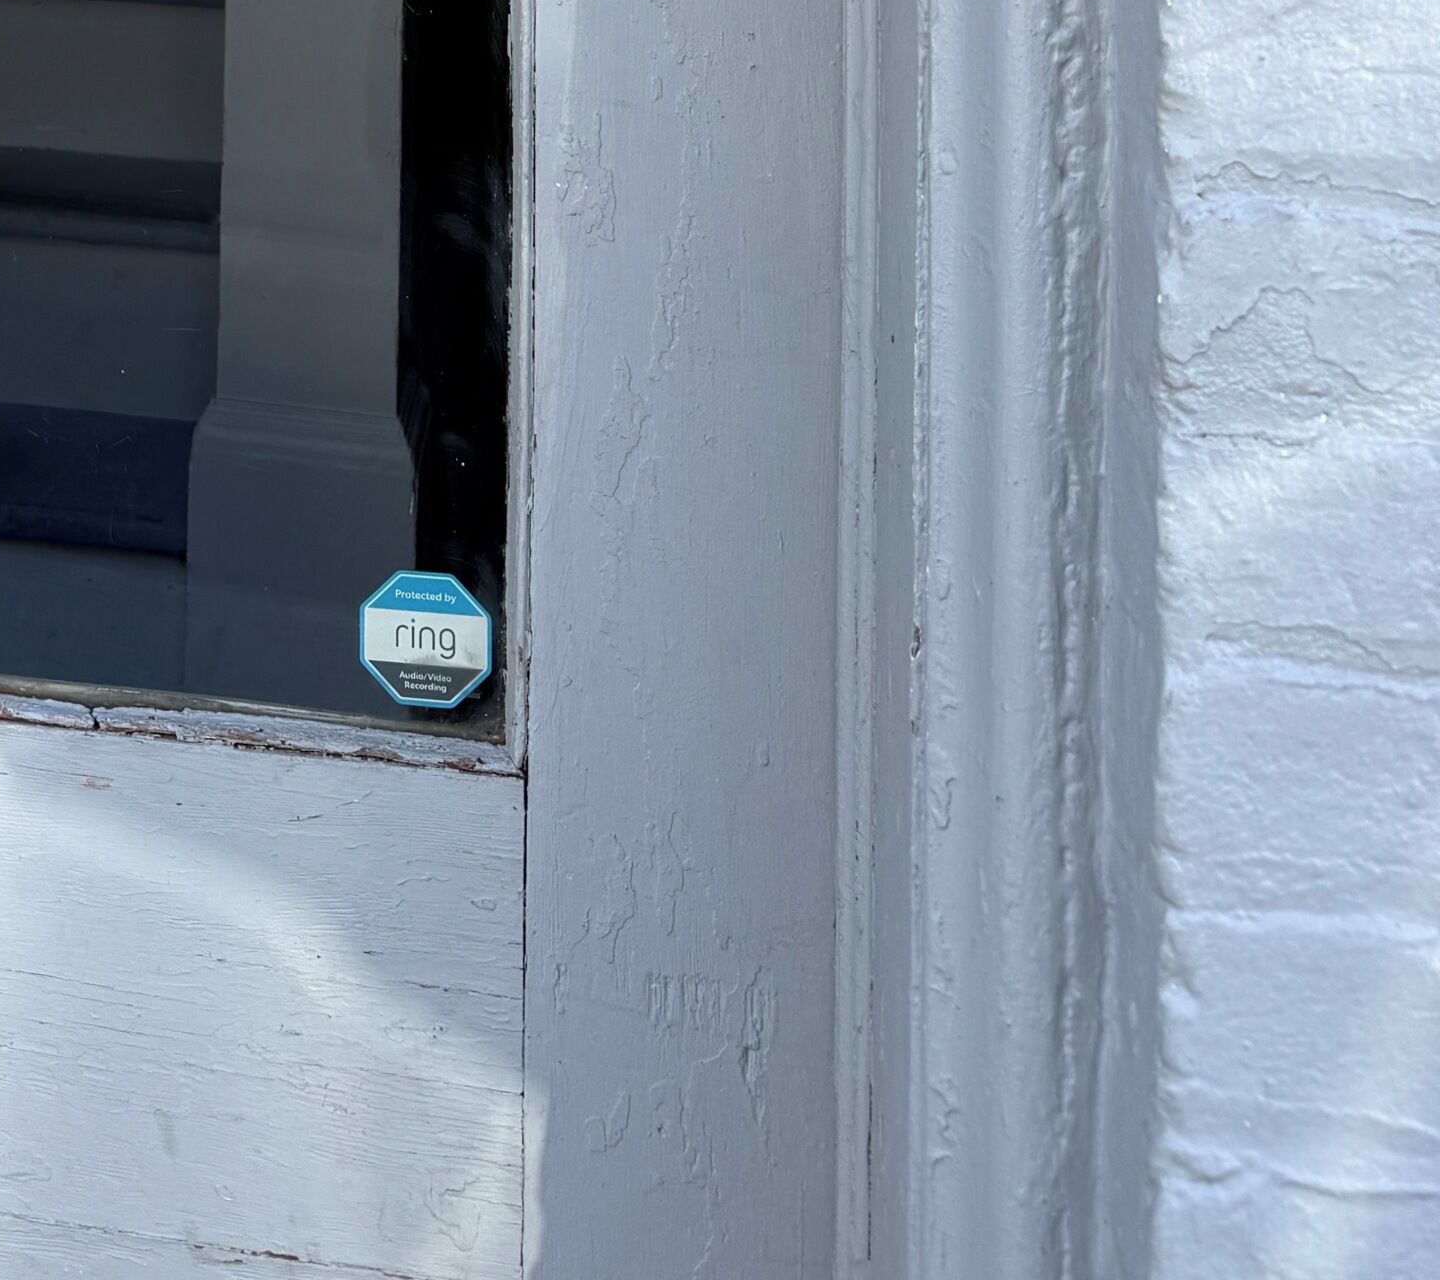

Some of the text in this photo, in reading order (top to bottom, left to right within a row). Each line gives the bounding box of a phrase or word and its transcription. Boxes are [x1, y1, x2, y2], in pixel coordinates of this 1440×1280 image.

[395, 589, 456, 604] Protected by
[395, 618, 456, 660] ring
[399, 671, 452, 682] Audio/Video
[404, 681, 447, 693] Recording
